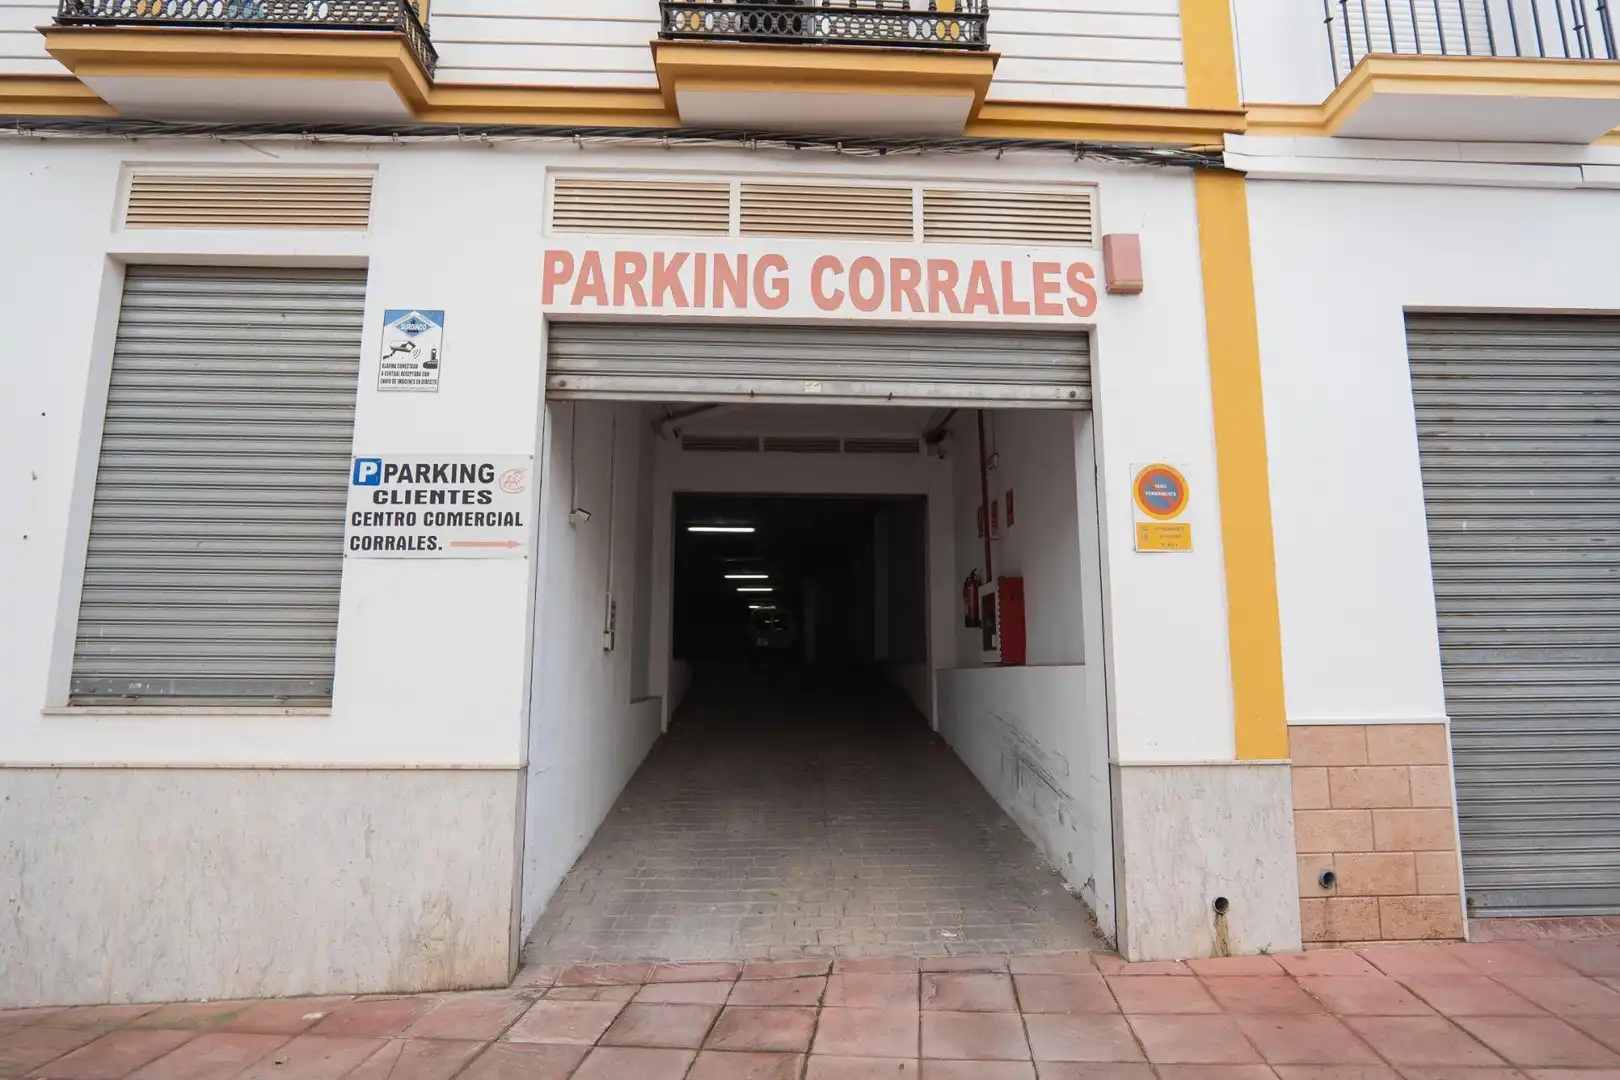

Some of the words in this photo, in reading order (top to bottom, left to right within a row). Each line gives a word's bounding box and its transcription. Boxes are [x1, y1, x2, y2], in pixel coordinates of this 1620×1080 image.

[541, 248, 790, 310] PARKING
[810, 254, 1098, 317] CORRALES
[358, 461, 378, 483] P
[384, 463, 495, 484] PARKING
[372, 489, 493, 505] CLIENTES
[351, 511, 417, 527] CENTRO
[423, 511, 523, 527] COMERCIAL
[350, 535, 443, 551] CORRALES.
